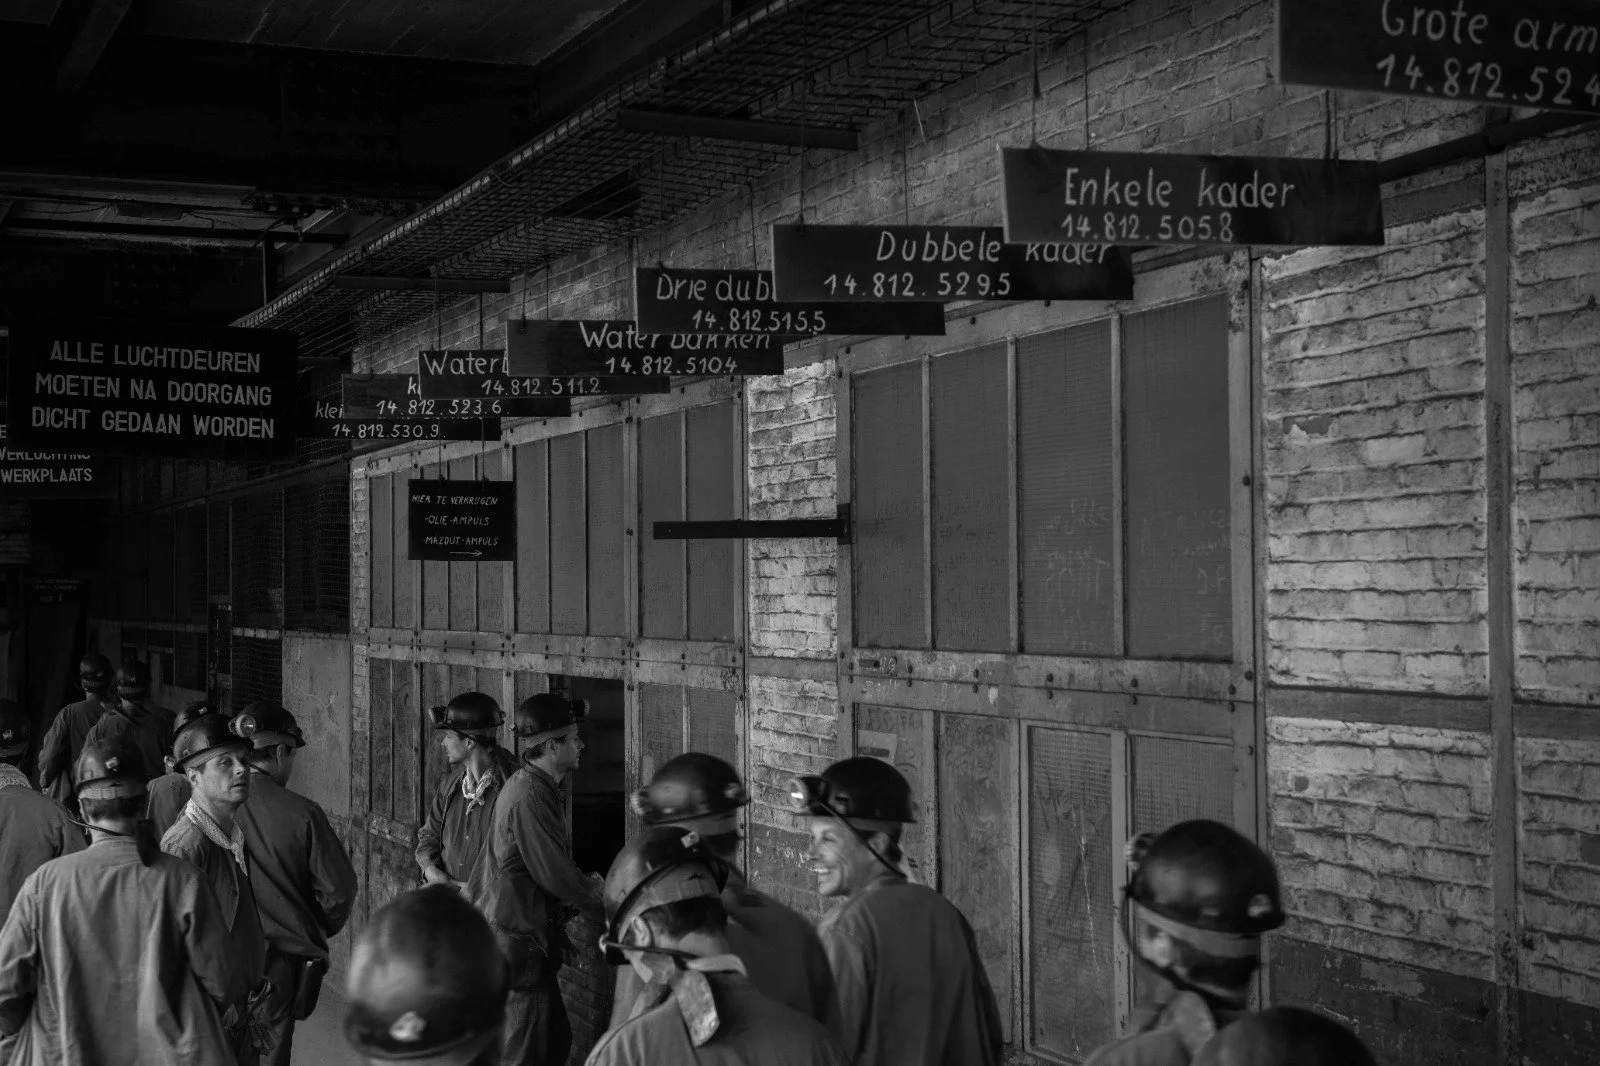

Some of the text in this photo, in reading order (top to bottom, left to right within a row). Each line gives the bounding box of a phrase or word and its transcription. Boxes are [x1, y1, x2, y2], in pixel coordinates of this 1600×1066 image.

[1381, 0, 1489, 45] Grote
[1064, 168, 1295, 209] Enkele kader
[1061, 211, 1233, 242] 14.812.505.8
[876, 231, 1002, 264] Dubbele
[656, 273, 707, 301] Drie
[50, 340, 261, 373] ALLE LUCHTDEUREN
[35, 372, 272, 406] MOETEN NA DOORGANG
[32, 406, 275, 439] DICHT GEDAAN WORDEN
[0, 468, 93, 484] WERKPLAATS
[411, 494, 431, 503] HIER
[437, 495, 447, 504] TE
